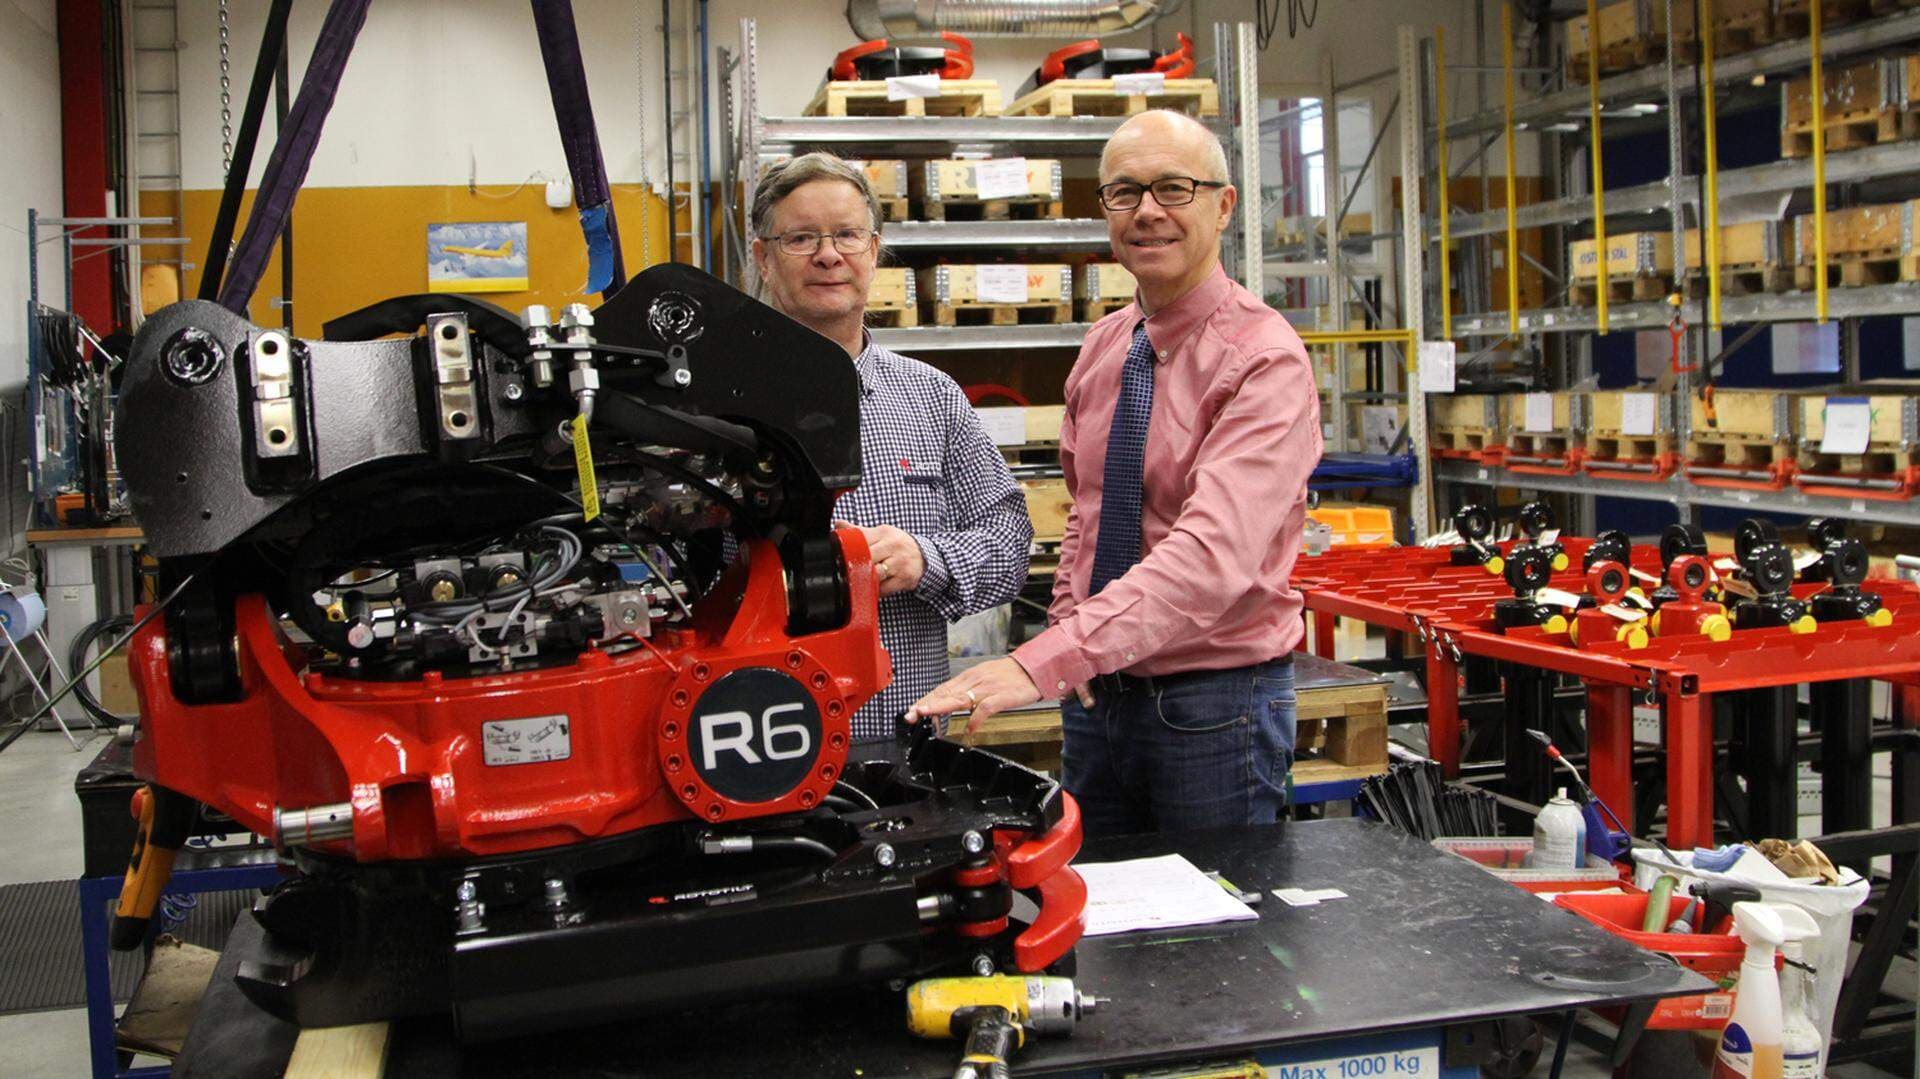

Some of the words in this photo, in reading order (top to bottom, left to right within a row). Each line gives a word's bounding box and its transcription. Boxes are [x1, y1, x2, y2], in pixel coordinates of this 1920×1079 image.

[699, 702, 811, 770] R6
[1280, 1066, 1326, 1079] Max
[1338, 1056, 1386, 1078] 1000
[1394, 1054, 1420, 1075] kg
